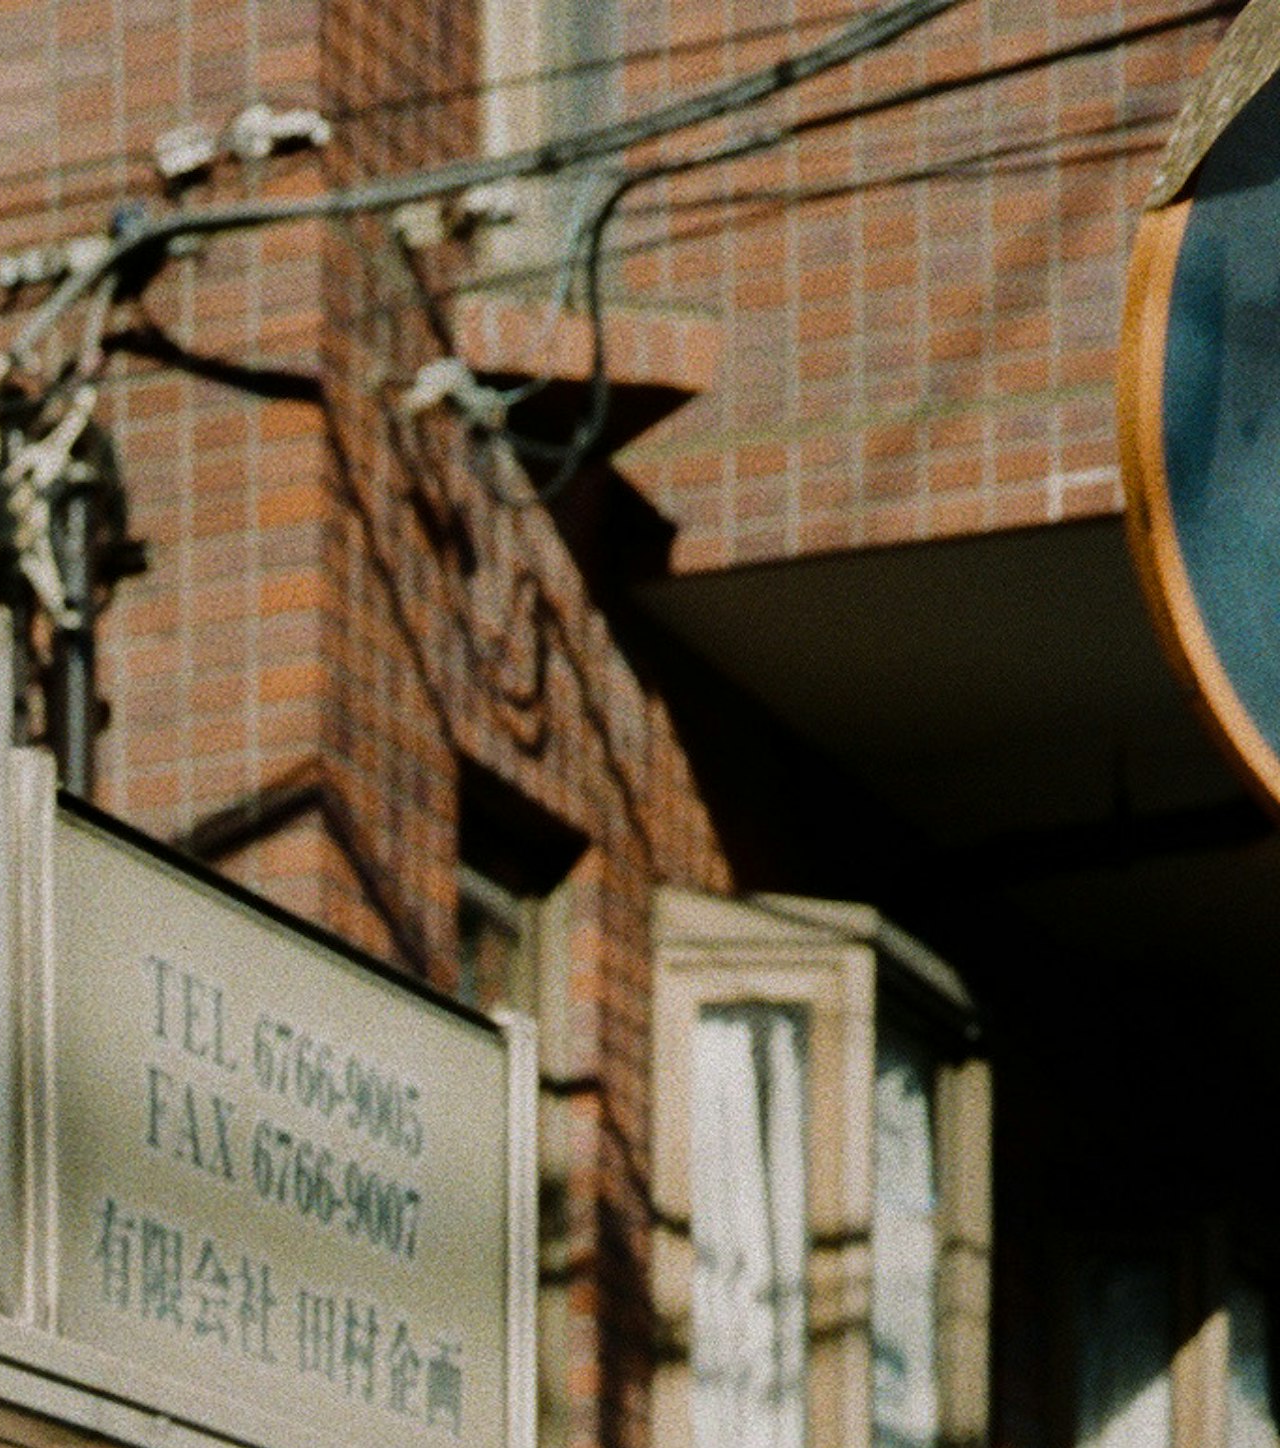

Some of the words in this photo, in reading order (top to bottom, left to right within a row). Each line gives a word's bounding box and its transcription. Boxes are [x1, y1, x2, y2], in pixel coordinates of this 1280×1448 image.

[147, 953, 237, 1073] TEL
[252, 1014, 425, 1157] 6766-9005
[145, 1066, 236, 1182] FAX
[252, 1118, 424, 1262] 6766-9007
[97, 1197, 278, 1363] 有限会社
